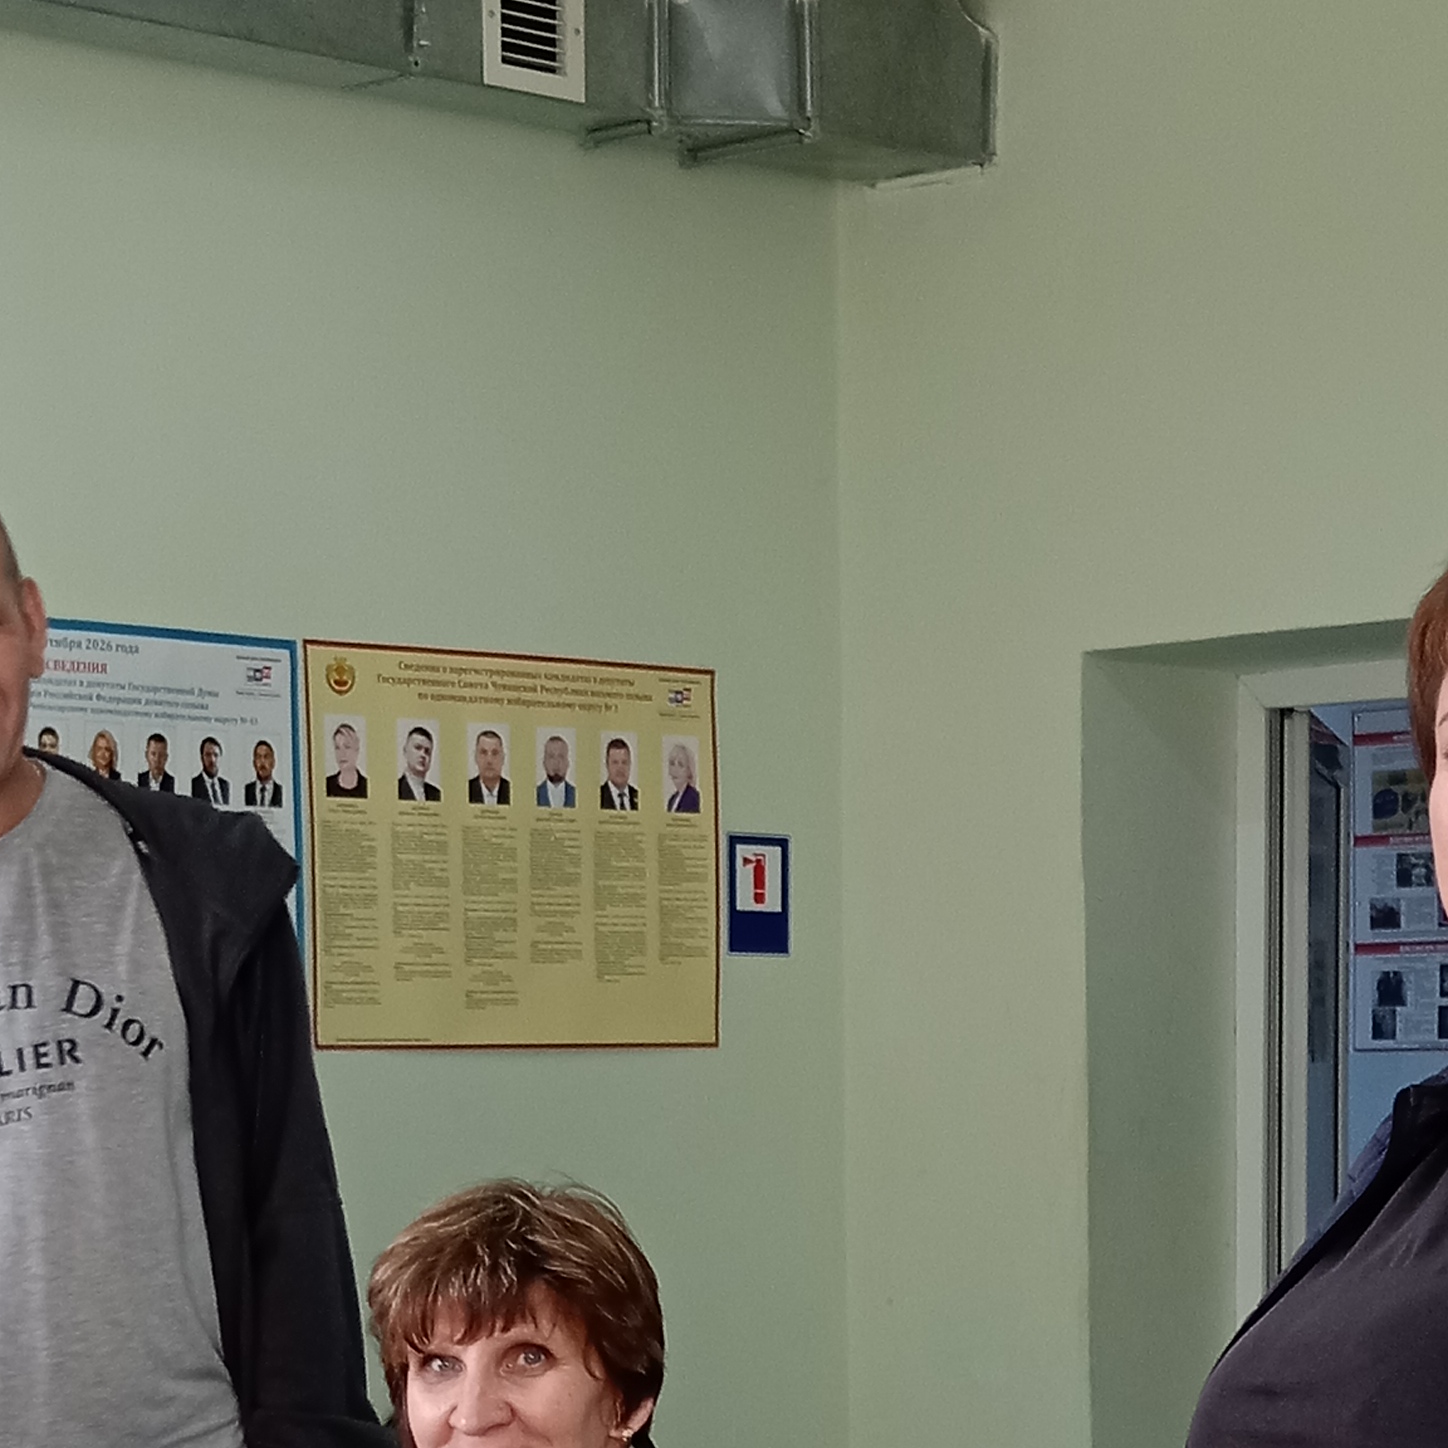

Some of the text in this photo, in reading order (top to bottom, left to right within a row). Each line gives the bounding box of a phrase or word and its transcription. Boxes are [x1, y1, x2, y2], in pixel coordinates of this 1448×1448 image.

[48, 637, 140, 654] тября 2026 года
[45, 659, 108, 675] СВЕДЕНИЯ
[61, 977, 165, 1061] Dior
